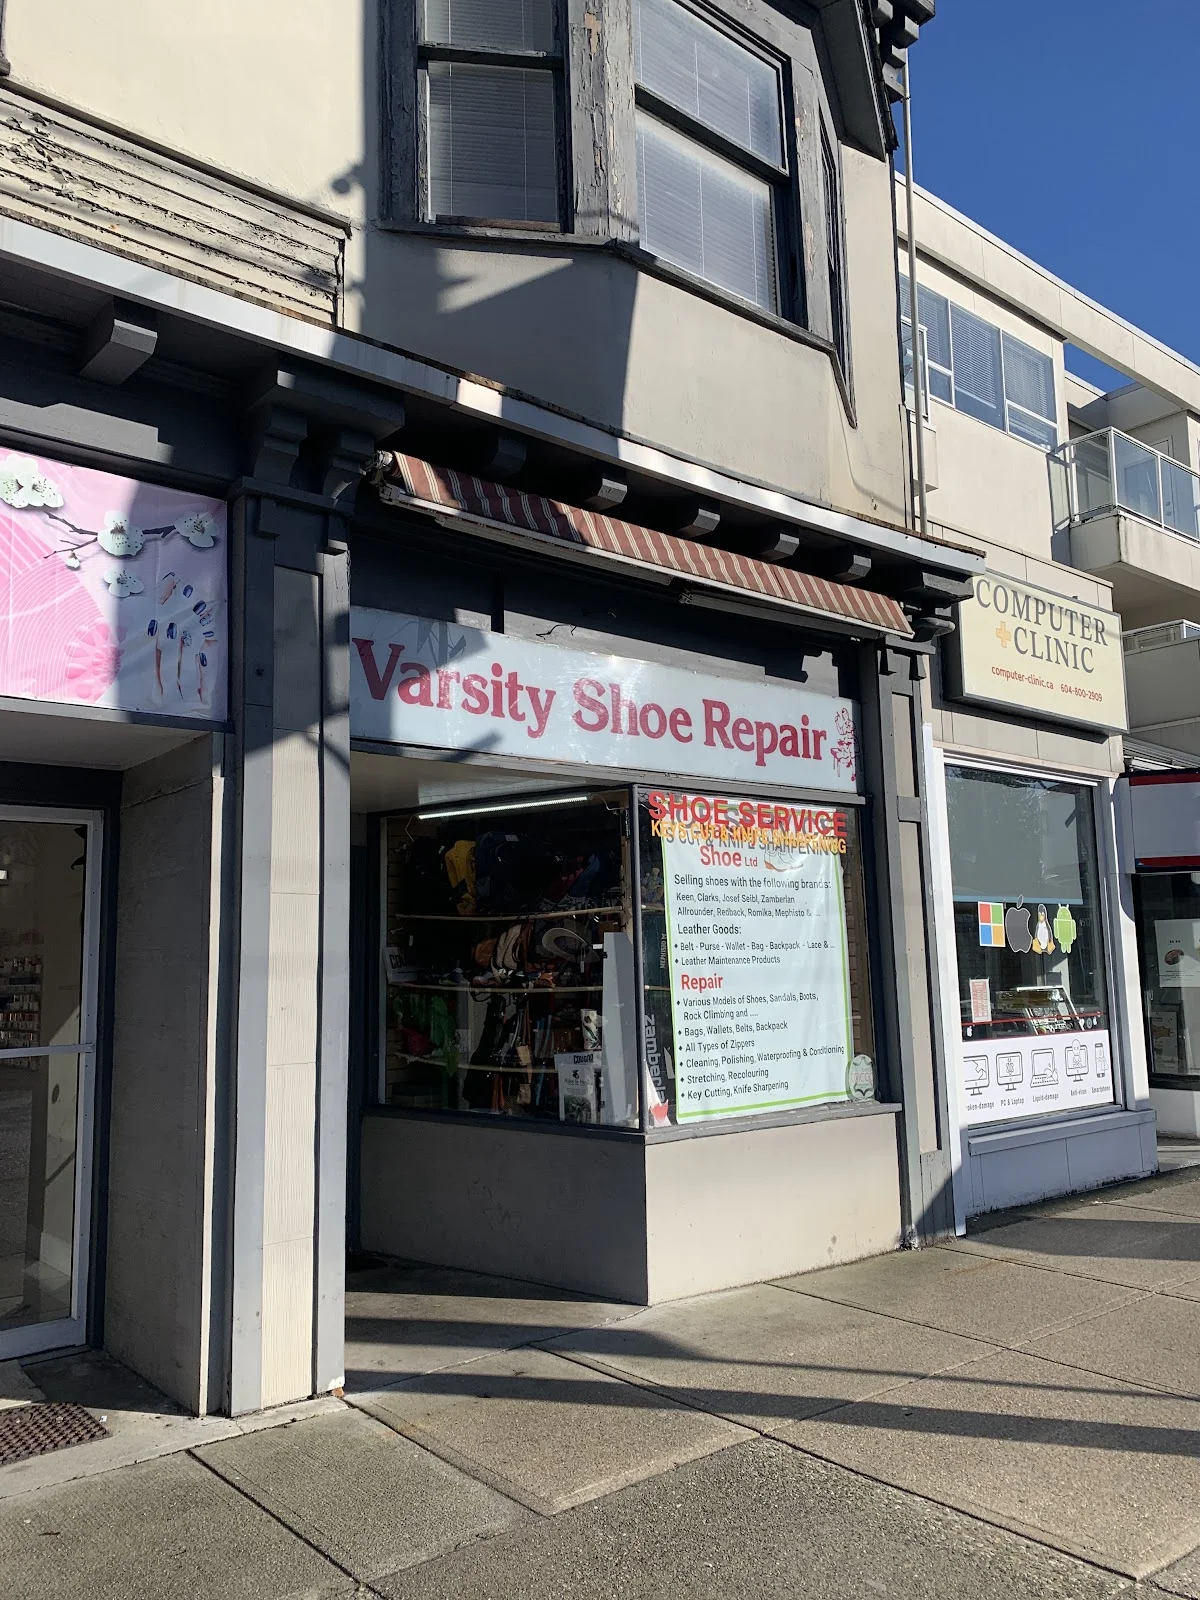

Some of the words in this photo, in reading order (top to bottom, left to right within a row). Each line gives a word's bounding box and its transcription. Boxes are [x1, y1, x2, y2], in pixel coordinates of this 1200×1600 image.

[976, 579, 1108, 646] COMPUTER
[1013, 626, 1095, 674] CLINIC
[991, 666, 1054, 690] computer-clinic.ca
[1060, 684, 1103, 702] 604-800-2909
[352, 637, 556, 738] Varsity
[572, 677, 693, 743] Shoe
[703, 699, 827, 767] Repair
[648, 791, 730, 825] SHOE
[739, 801, 848, 837] SERVICE
[651, 820, 687, 838] KEYS
[690, 823, 716, 841] CUT
[700, 845, 742, 867] Shoe
[744, 857, 758, 867] Ltd
[674, 874, 703, 888] Selling
[705, 876, 729, 887] shoes
[731, 876, 747, 887] with
[749, 877, 762, 888] the
[763, 877, 800, 891] following
[801, 879, 831, 889] brands:
[676, 892, 696, 903] Keen,
[697, 893, 720, 903] Clarks,
[722, 894, 740, 903] Josef
[742, 894, 760, 904] Seibl,
[761, 894, 795, 904] Zamberlan
[677, 907, 715, 917] Allrounder,
[716, 907, 746, 918] Redback,
[747, 908, 774, 918] Romika,
[775, 908, 805, 919] Mephisto
[677, 923, 710, 935] Leather
[712, 923, 742, 935] Goods:
[680, 942, 694, 951] Belt
[700, 942, 720, 951] Purse
[725, 942, 746, 951] Wallet
[751, 942, 764, 952] Bag
[769, 941, 800, 951] Backpack
[807, 941, 822, 949] Lace
[823, 940, 829, 949] &
[681, 956, 706, 966] Leather
[708, 956, 751, 965] Maintenance
[751, 955, 781, 964] Products
[681, 973, 723, 993] Repair
[683, 998, 711, 1007] Various
[712, 996, 736, 1005] Models
[738, 995, 745, 1004] of
[746, 995, 769, 1004] Shoes,
[769, 992, 799, 1003] Sandals,
[799, 992, 819, 1001] Boots,
[683, 1011, 702, 1020] Rock
[703, 1009, 734, 1020] Climbing
[736, 1008, 749, 1017] and
[684, 1027, 706, 1038] Bags,
[706, 1025, 735, 1035] Wallets,
[735, 1023, 755, 1033] Belts,
[755, 1020, 789, 1032] Backpack
[685, 1042, 696, 1052] All
[697, 1042, 719, 1053] Types
[720, 1040, 729, 1049] of
[730, 1040, 755, 1050] Zippers
[644, 1014, 666, 1104] zamberla
[686, 1057, 720, 1068] Cleaning,
[721, 1054, 756, 1065] Polishing,
[757, 1050, 802, 1062] Waterproofing
[802, 1048, 808, 1057] &
[809, 1045, 844, 1056] Conditioning
[687, 1072, 727, 1084] Stretching,
[728, 1068, 769, 1080] Recolouring
[687, 1090, 703, 1101] Key
[704, 1087, 733, 1098] Cutting,
[733, 1084, 752, 1094] Knife
[753, 1080, 789, 1092] Sharpening
[966, 1102, 995, 1111] oken-damage
